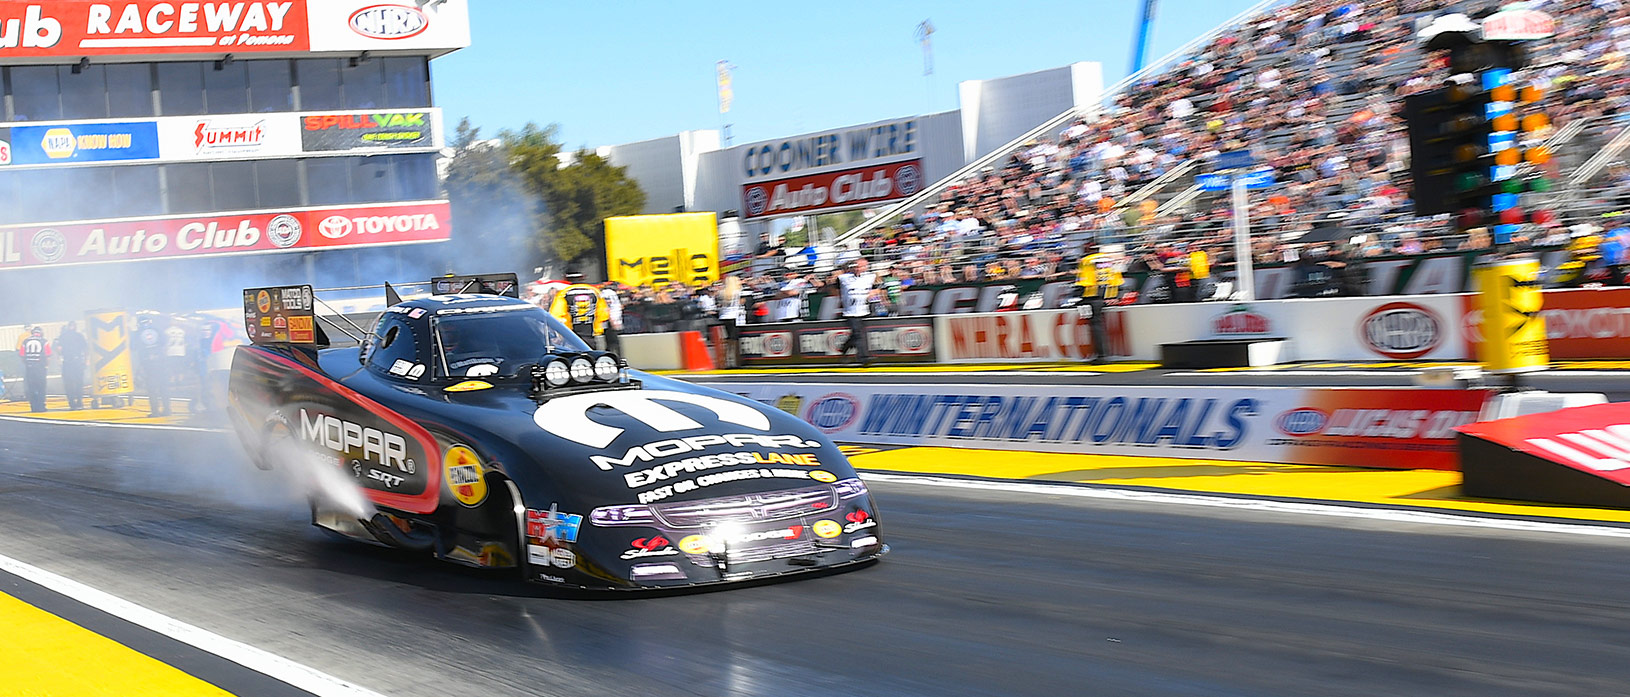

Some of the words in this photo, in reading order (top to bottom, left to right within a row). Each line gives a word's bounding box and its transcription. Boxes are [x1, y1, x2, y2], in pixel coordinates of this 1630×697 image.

[86, 2, 293, 35] RACEWAY
[355, 8, 422, 35] NHRA
[218, 34, 237, 45] at
[236, 34, 294, 45] Pomona
[304, 112, 425, 131] SPILLVAK
[77, 134, 107, 149] KNOW
[108, 133, 132, 148] HOW
[846, 121, 918, 163] WIRE
[767, 182, 830, 211] Auto
[829, 170, 894, 204] Club
[352, 213, 440, 235] TOYOTA
[77, 228, 168, 256] Auto
[175, 219, 261, 250] Club
[857, 393, 1261, 450] WINTERNATIONALS
[366, 468, 405, 488] SRT
[637, 485, 674, 504] FAST
[673, 480, 700, 493] OIL
